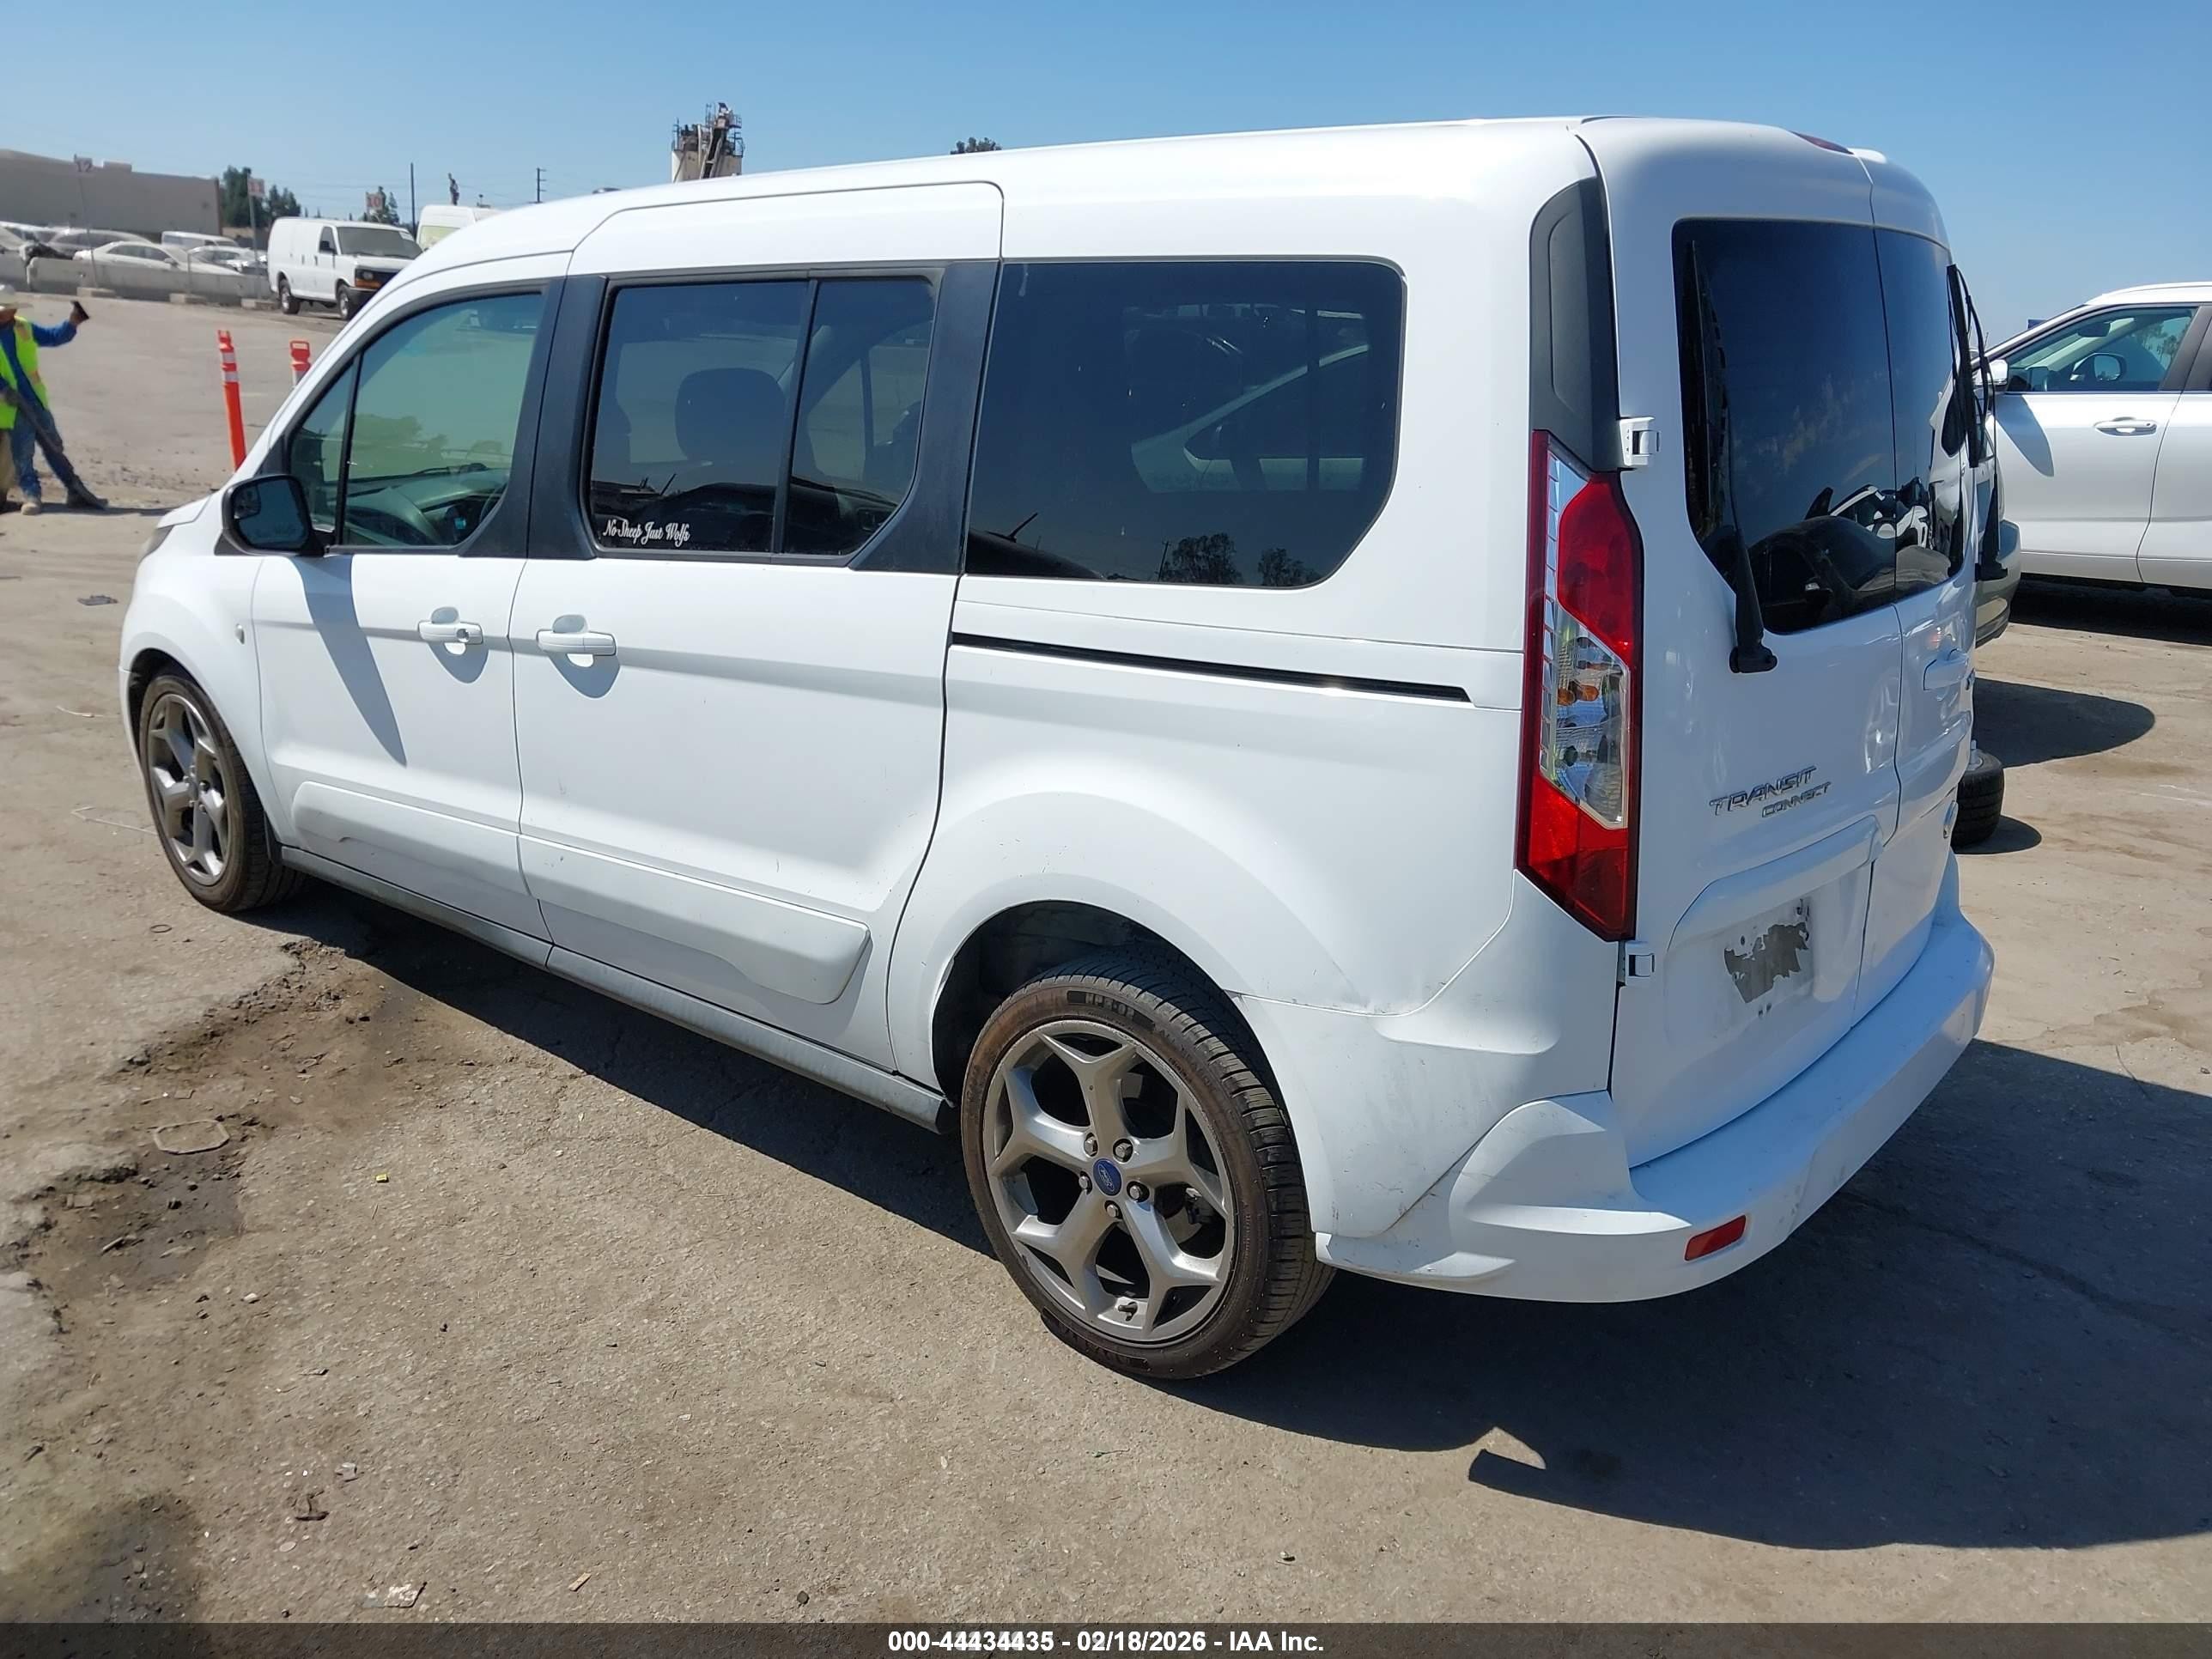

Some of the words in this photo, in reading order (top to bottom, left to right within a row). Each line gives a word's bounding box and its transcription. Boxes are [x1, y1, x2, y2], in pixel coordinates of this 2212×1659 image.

[603, 519, 619, 537] No
[617, 520, 643, 545] Sheep
[641, 521, 664, 545] Just
[665, 523, 690, 548] Wolfs
[1709, 765, 1817, 816] TRANSIT
[1761, 781, 1832, 818] CONNECT
